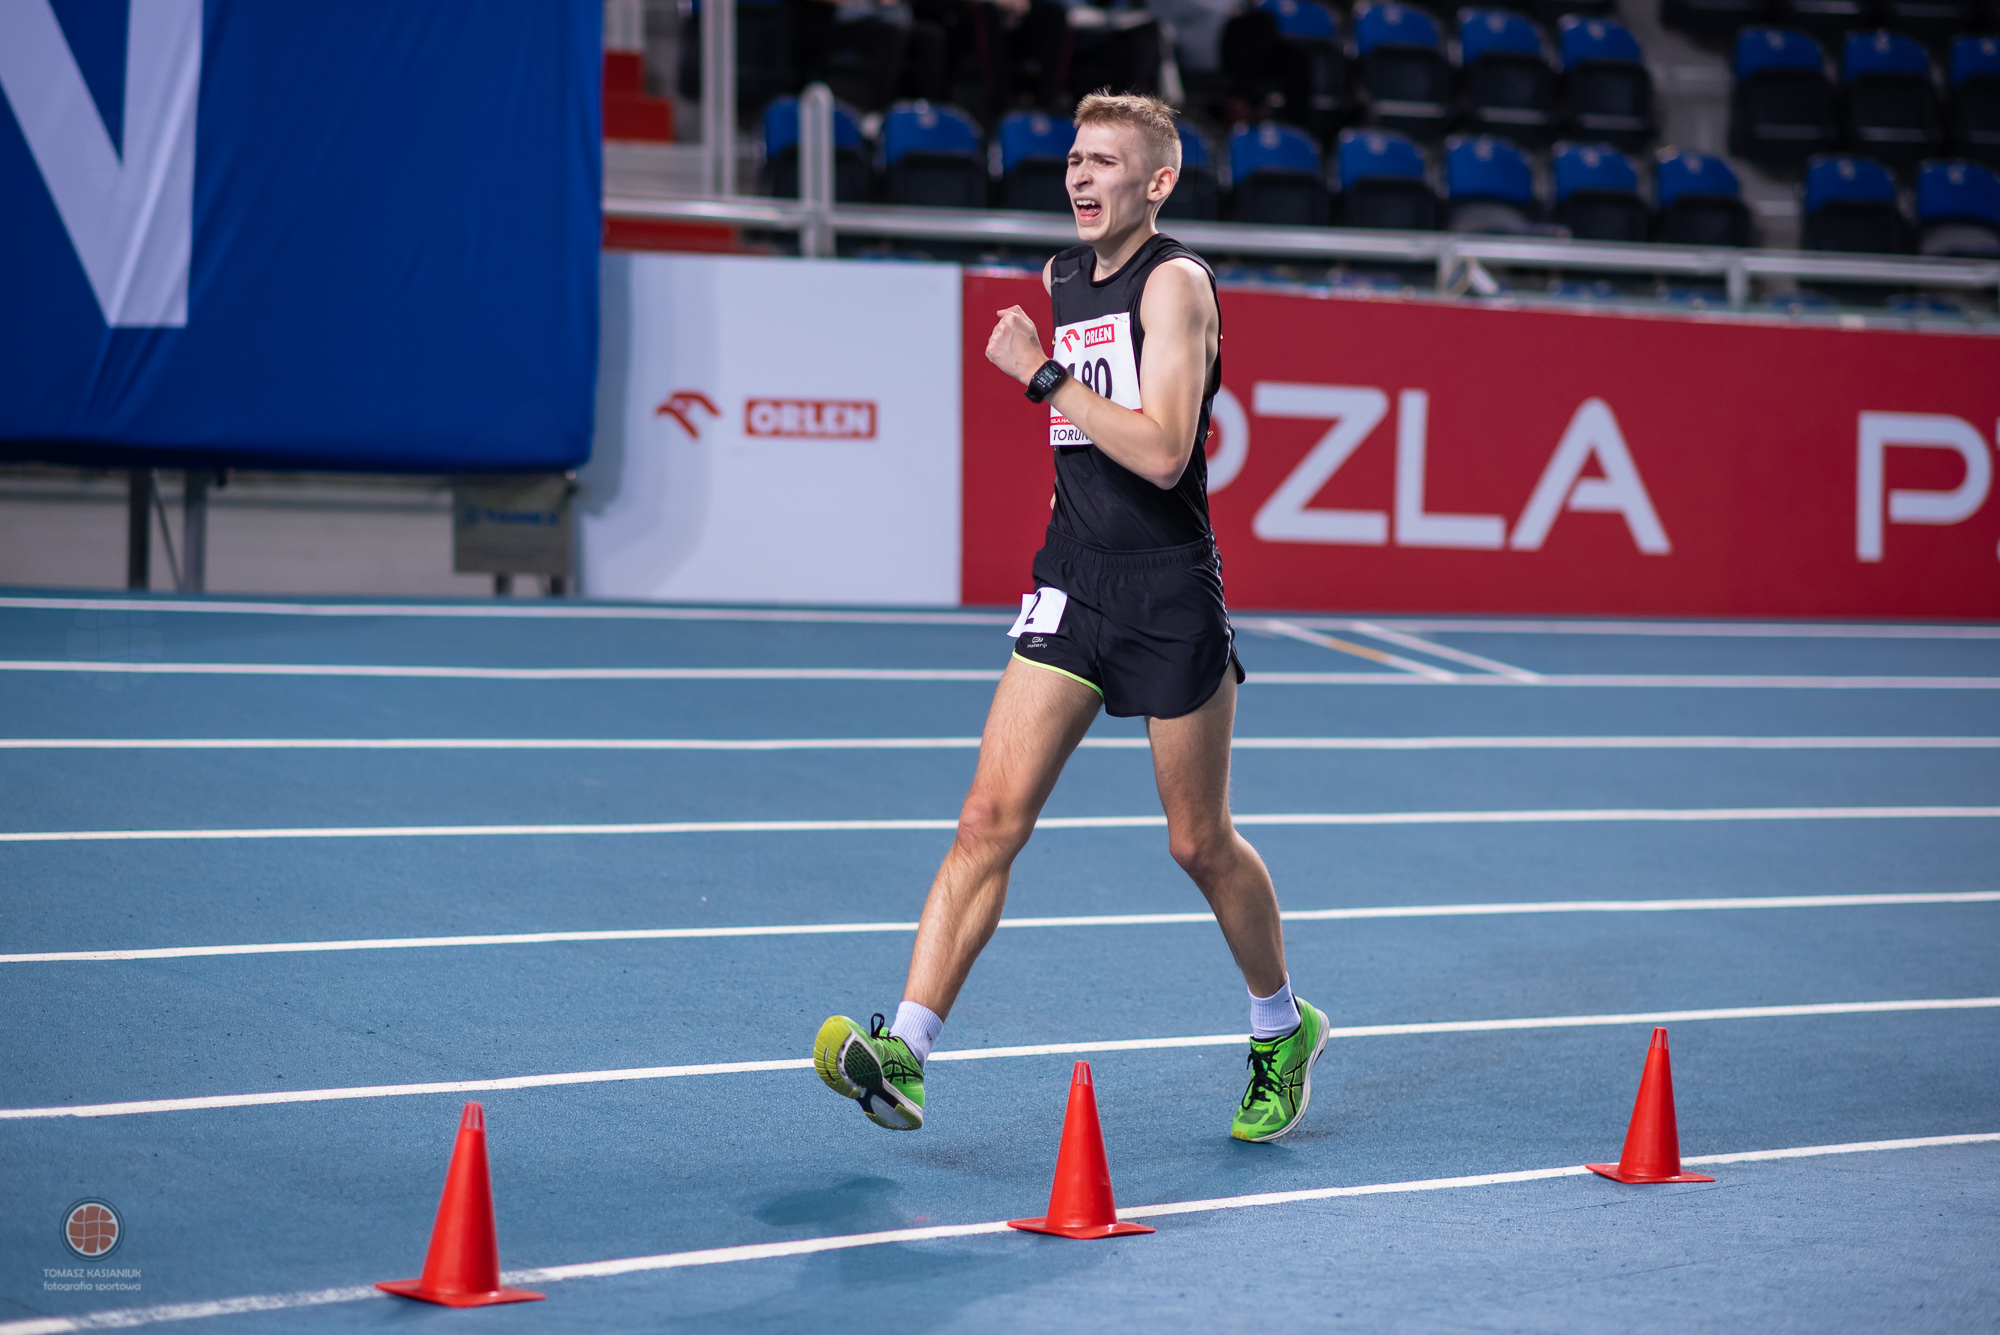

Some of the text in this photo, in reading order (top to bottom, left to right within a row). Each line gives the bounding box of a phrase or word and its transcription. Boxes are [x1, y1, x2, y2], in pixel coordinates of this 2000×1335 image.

[1085, 326, 1112, 346] ORLEN
[749, 403, 870, 435] ORLEN
[1856, 411, 2000, 563] P
[1024, 590, 1042, 626] 2
